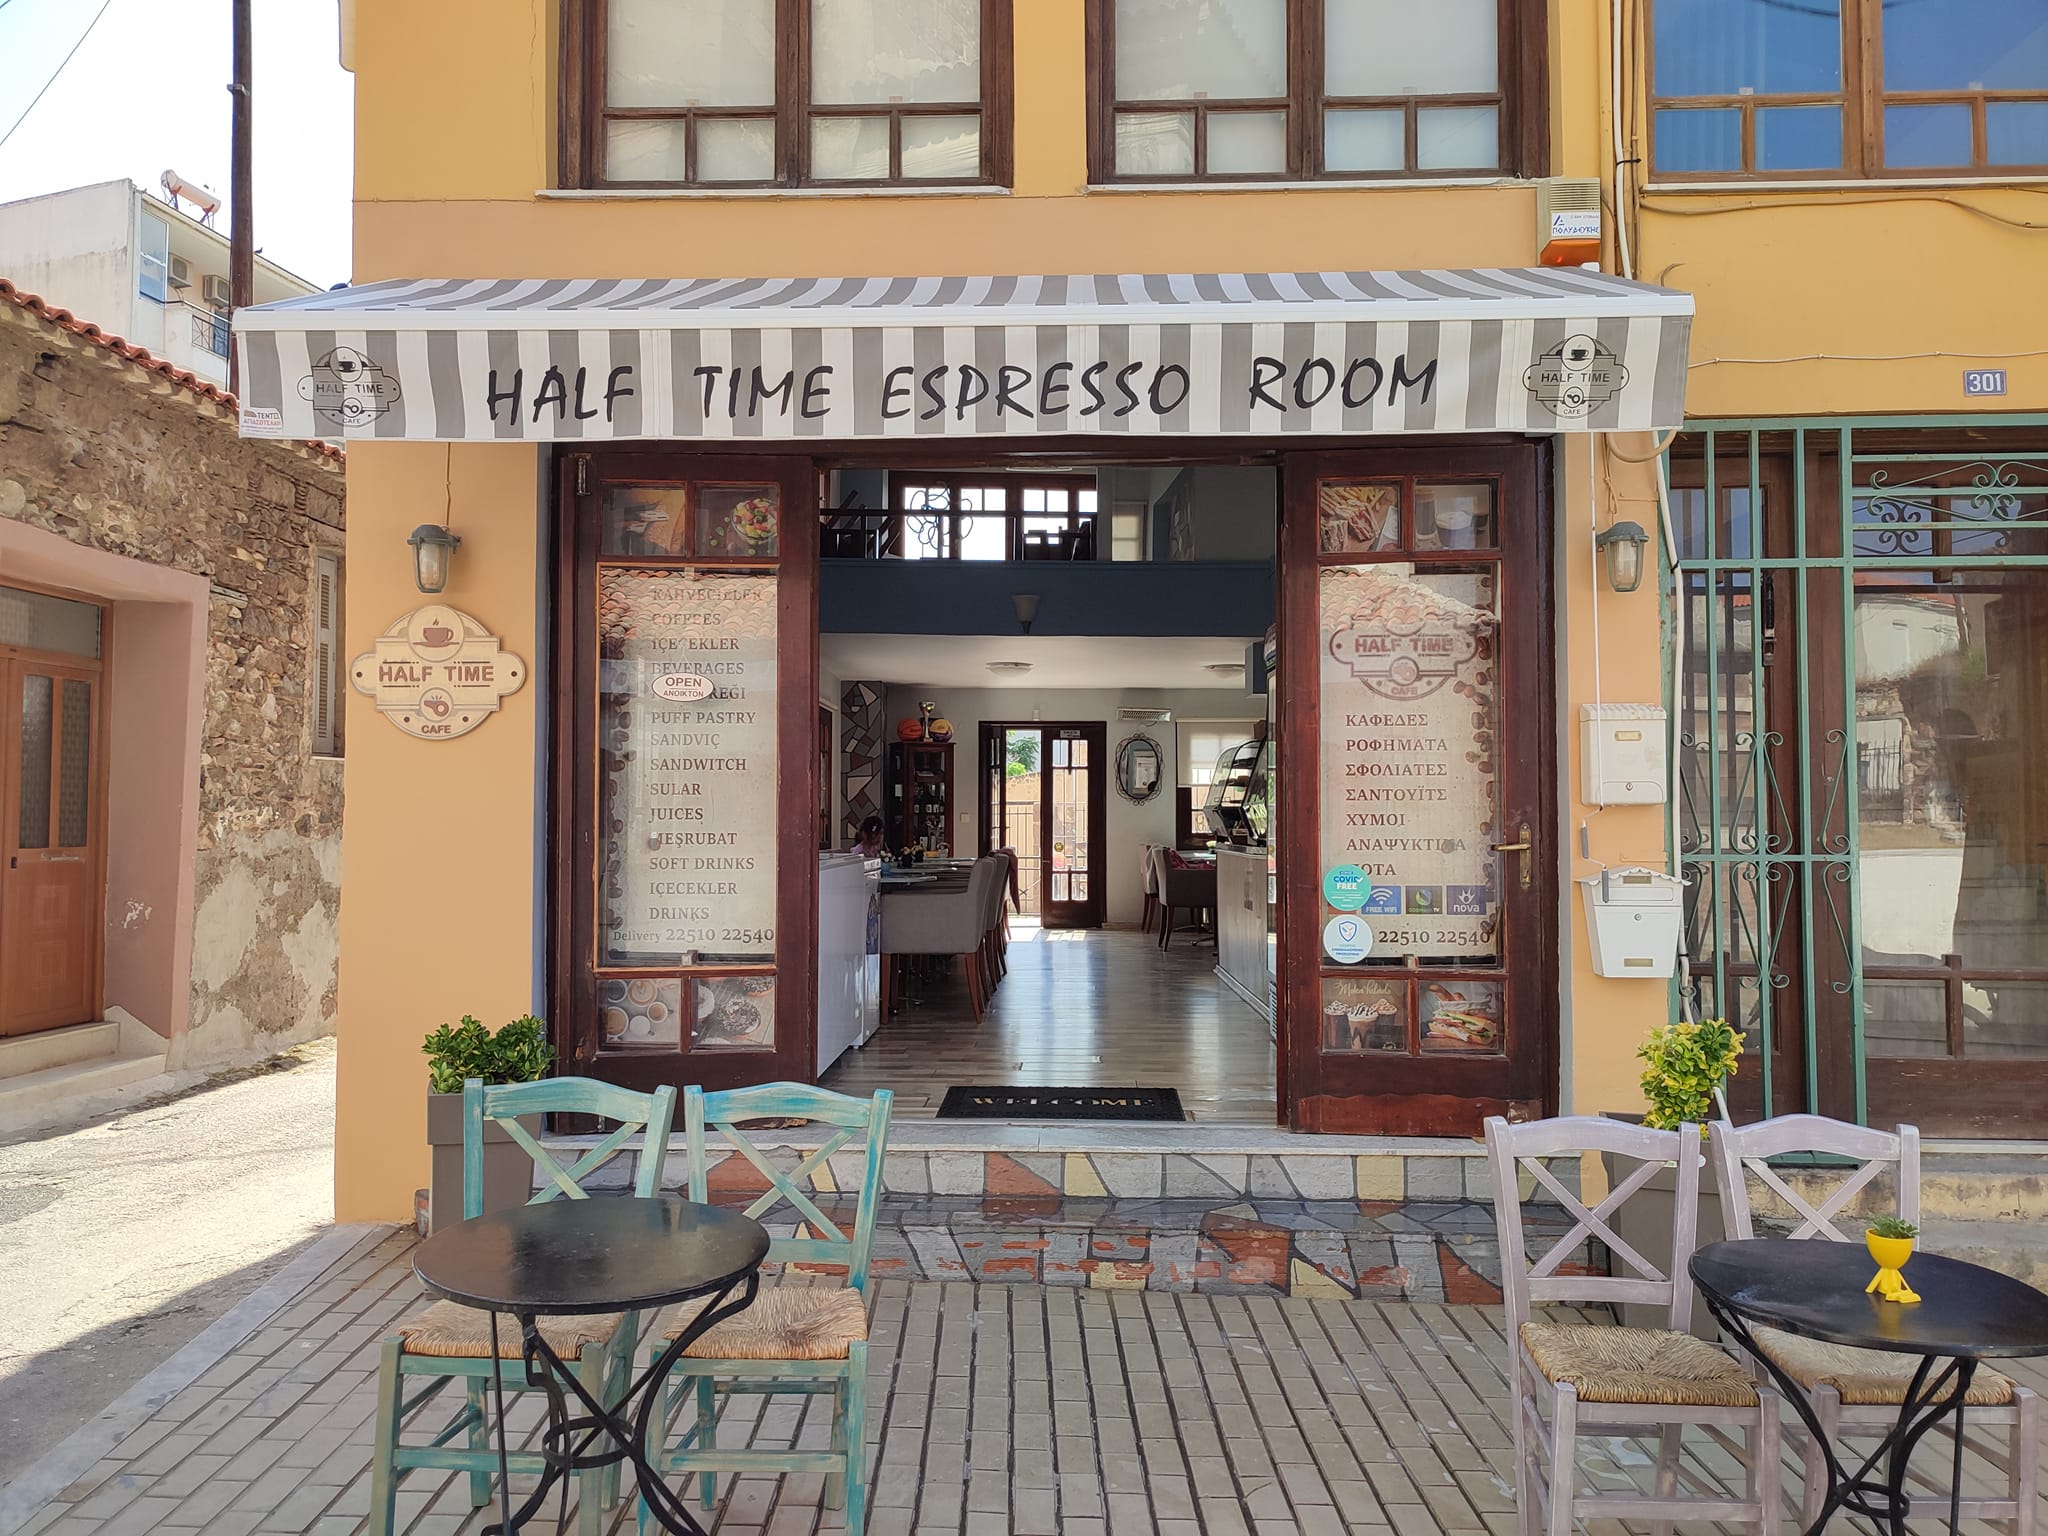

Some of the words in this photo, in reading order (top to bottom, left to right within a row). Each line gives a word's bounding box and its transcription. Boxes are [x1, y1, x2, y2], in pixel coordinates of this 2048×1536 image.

[1541, 372, 1574, 383] HALF
[1580, 372, 1611, 383] TIME
[1969, 373, 2002, 392] 301
[316, 383, 348, 394] HALF
[355, 383, 385, 395] TIME
[487, 365, 634, 426] HALF
[693, 365, 834, 419] TIME
[881, 361, 1190, 421] ESPRESSO
[1249, 354, 1438, 412] ROOM
[652, 613, 721, 626] COFFEES
[1354, 638, 1402, 653] HALF
[1409, 637, 1454, 652] TIME
[378, 666, 433, 682] HALF
[444, 666, 495, 682] TIME
[651, 662, 745, 675] BEVERAGES
[665, 677, 702, 687] OPEN
[1391, 686, 1419, 696] CAFE
[651, 711, 691, 725] PUFF
[697, 712, 757, 724] PASTRY
[1345, 714, 1429, 727] ΚΑΦΕΔΕΣ
[421, 725, 452, 735] CAFE
[651, 734, 720, 749] SANDVIÇ
[1346, 739, 1449, 752] ΡΟΦΗΜΑΤΑ
[650, 758, 747, 771] SANDWITCH
[1345, 763, 1448, 777] ΣΦΟΛΙΑΤΕΣ
[650, 783, 702, 796] SULAR
[648, 807, 704, 823] JUICES
[1346, 813, 1406, 826] ΧΥΜΟΙ
[649, 857, 689, 870] SOFT
[694, 857, 755, 870] DRINKS
[1357, 863, 1397, 876] ΟΤΑ
[1333, 875, 1361, 883] COVID
[1336, 882, 1358, 890] FREE
[649, 907, 710, 920] DRINKS
[1453, 904, 1480, 913] nova
[613, 931, 662, 943] Delivery
[666, 929, 716, 943] 22510
[721, 929, 775, 944] 22540
[1378, 930, 1430, 946] 22510
[1436, 930, 1491, 946] 22540
